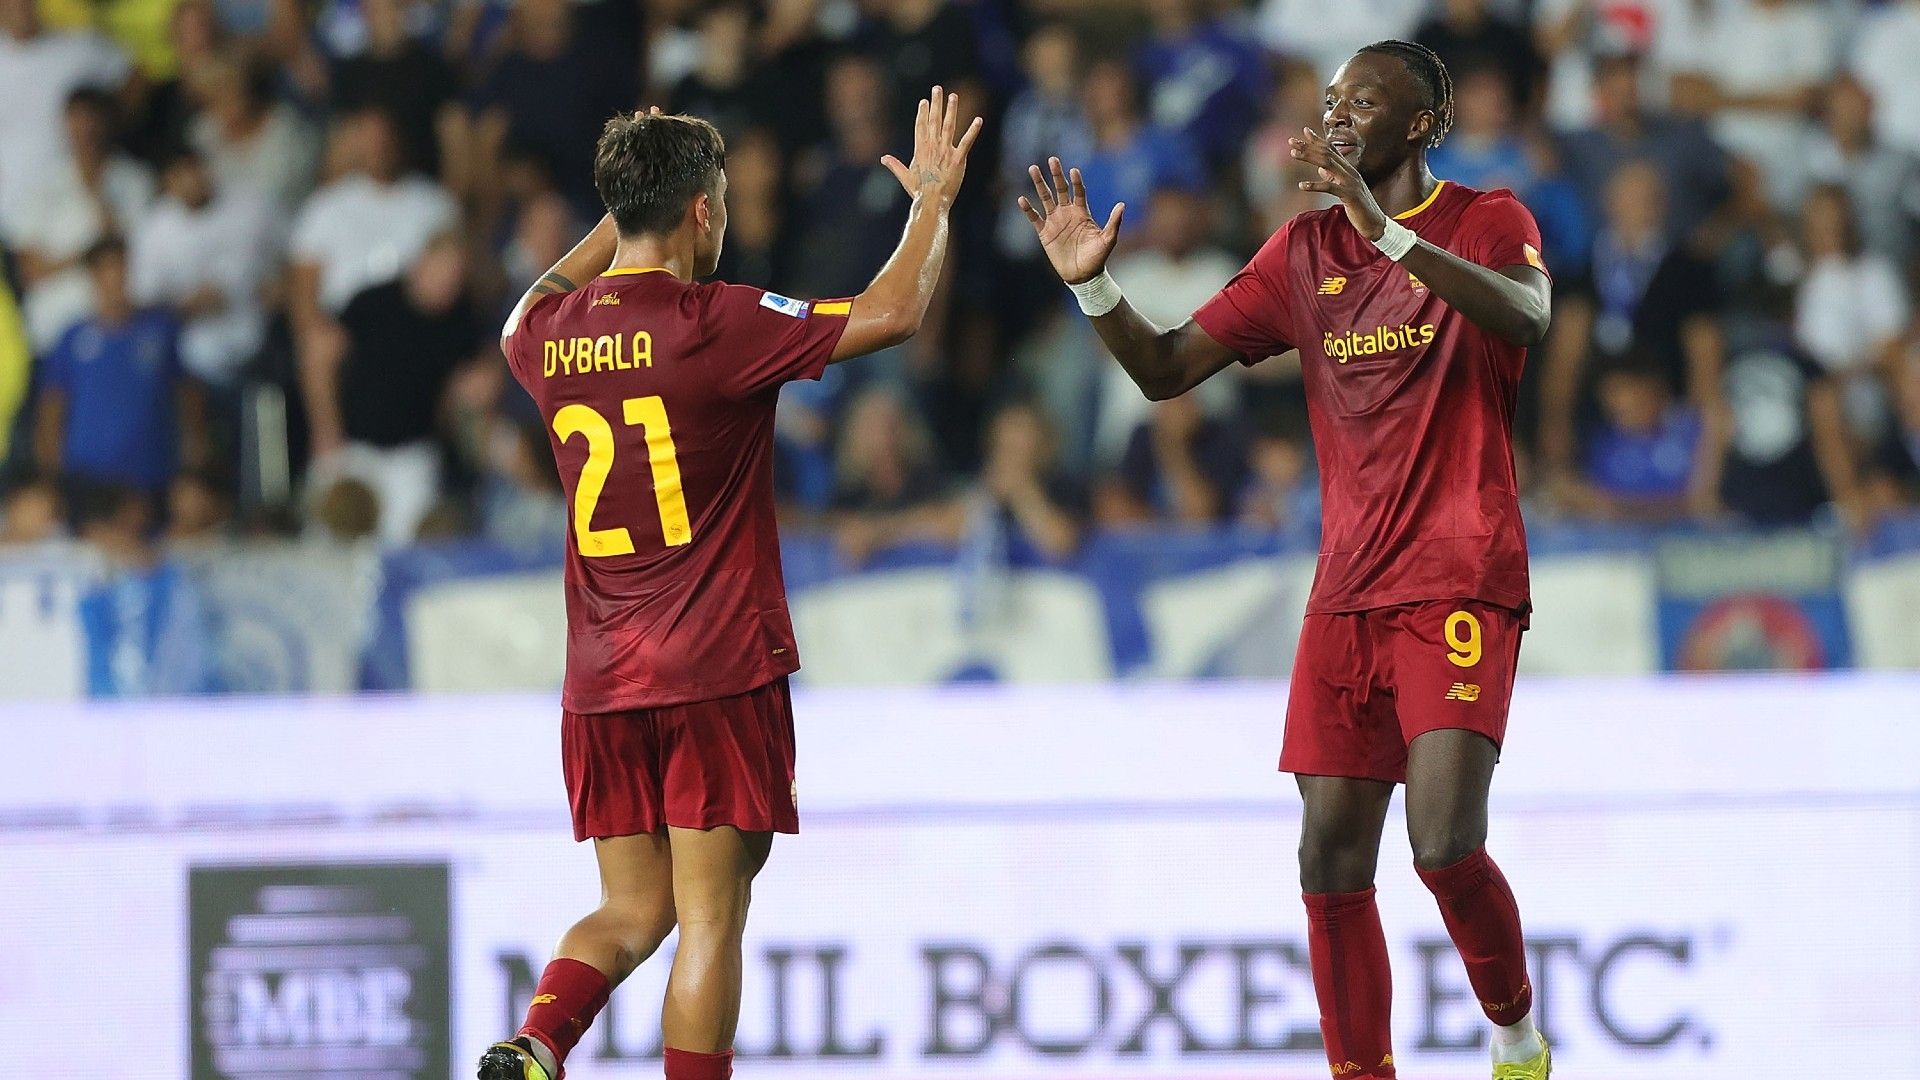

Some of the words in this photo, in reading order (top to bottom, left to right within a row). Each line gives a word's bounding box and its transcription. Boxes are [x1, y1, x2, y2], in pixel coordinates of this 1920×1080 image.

[544, 330, 652, 378] DYBALA
[1323, 324, 1434, 363] digitalbits
[552, 395, 692, 557] 21
[1444, 610, 1482, 667] 9
[496, 949, 881, 1056] MIL
[921, 945, 1322, 1054] BOXE
